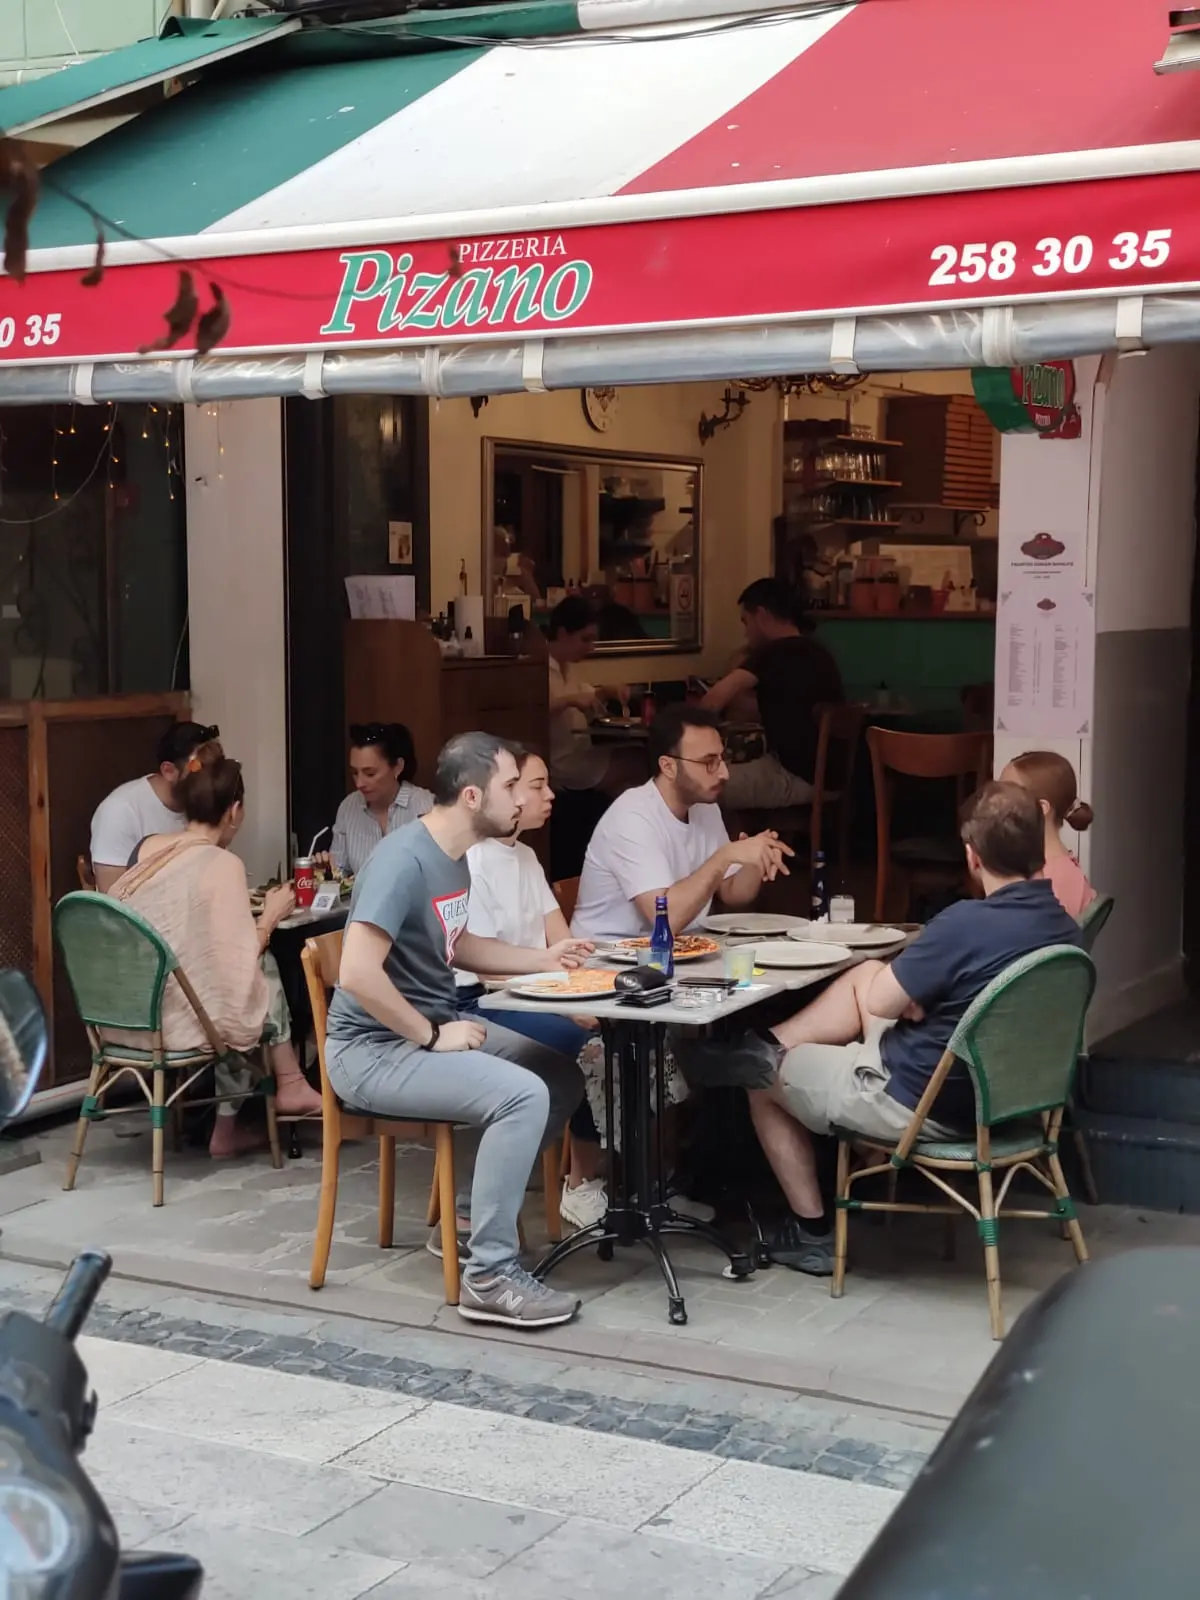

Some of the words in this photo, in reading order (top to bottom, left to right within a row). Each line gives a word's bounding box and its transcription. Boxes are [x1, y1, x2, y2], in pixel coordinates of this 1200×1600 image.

[458, 235, 568, 263] PIZZERIA
[928, 241, 1017, 286] 258
[1032, 235, 1093, 276] 30
[1108, 229, 1172, 270] 35
[320, 250, 593, 335] Pizano
[23, 313, 62, 347] 35
